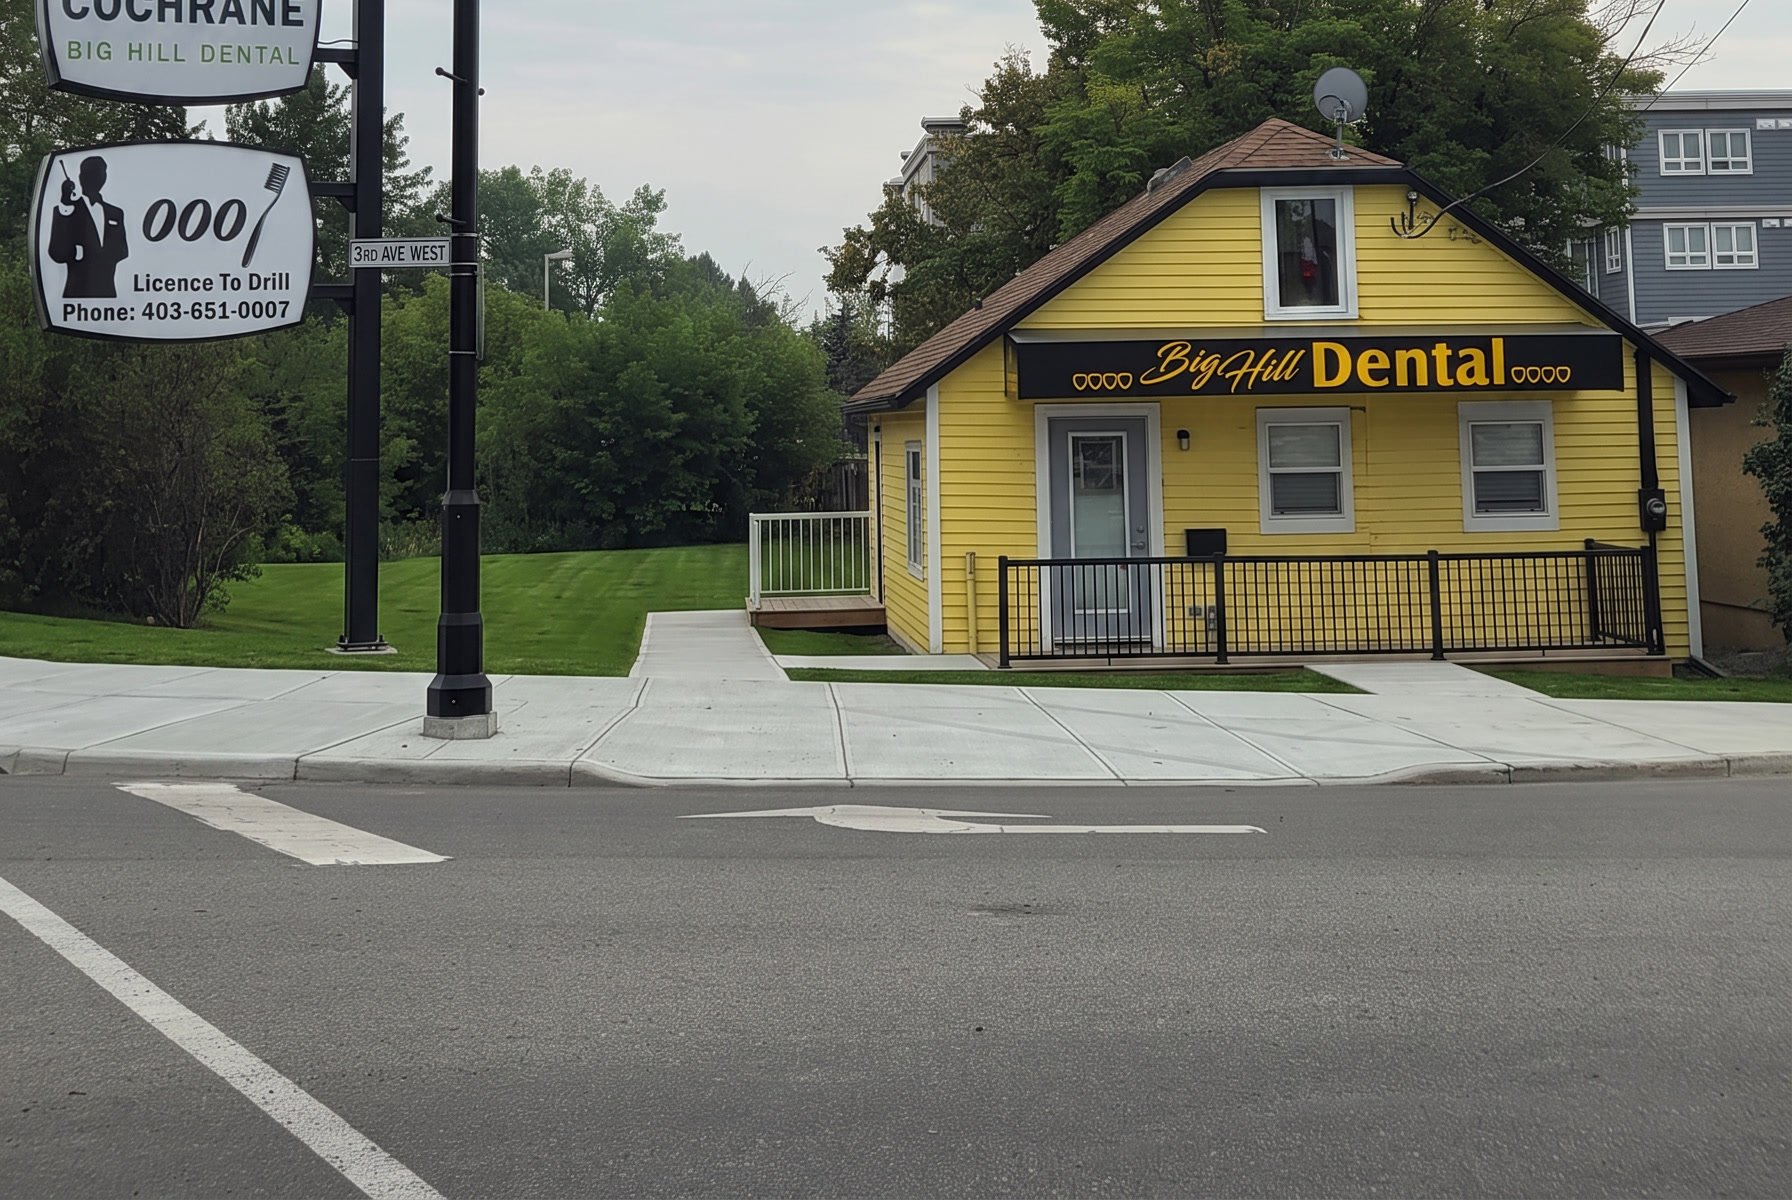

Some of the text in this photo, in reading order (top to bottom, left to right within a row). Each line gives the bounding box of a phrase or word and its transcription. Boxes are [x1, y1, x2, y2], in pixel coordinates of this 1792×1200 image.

[68, 41, 300, 65] BIG HILL DENTAL
[353, 245, 446, 262] 3RD AVE WEST
[133, 272, 290, 292] Licence To Drill
[63, 301, 290, 321] Phone: 403-651-0007
[1139, 337, 1506, 394] Big Hill Dental
